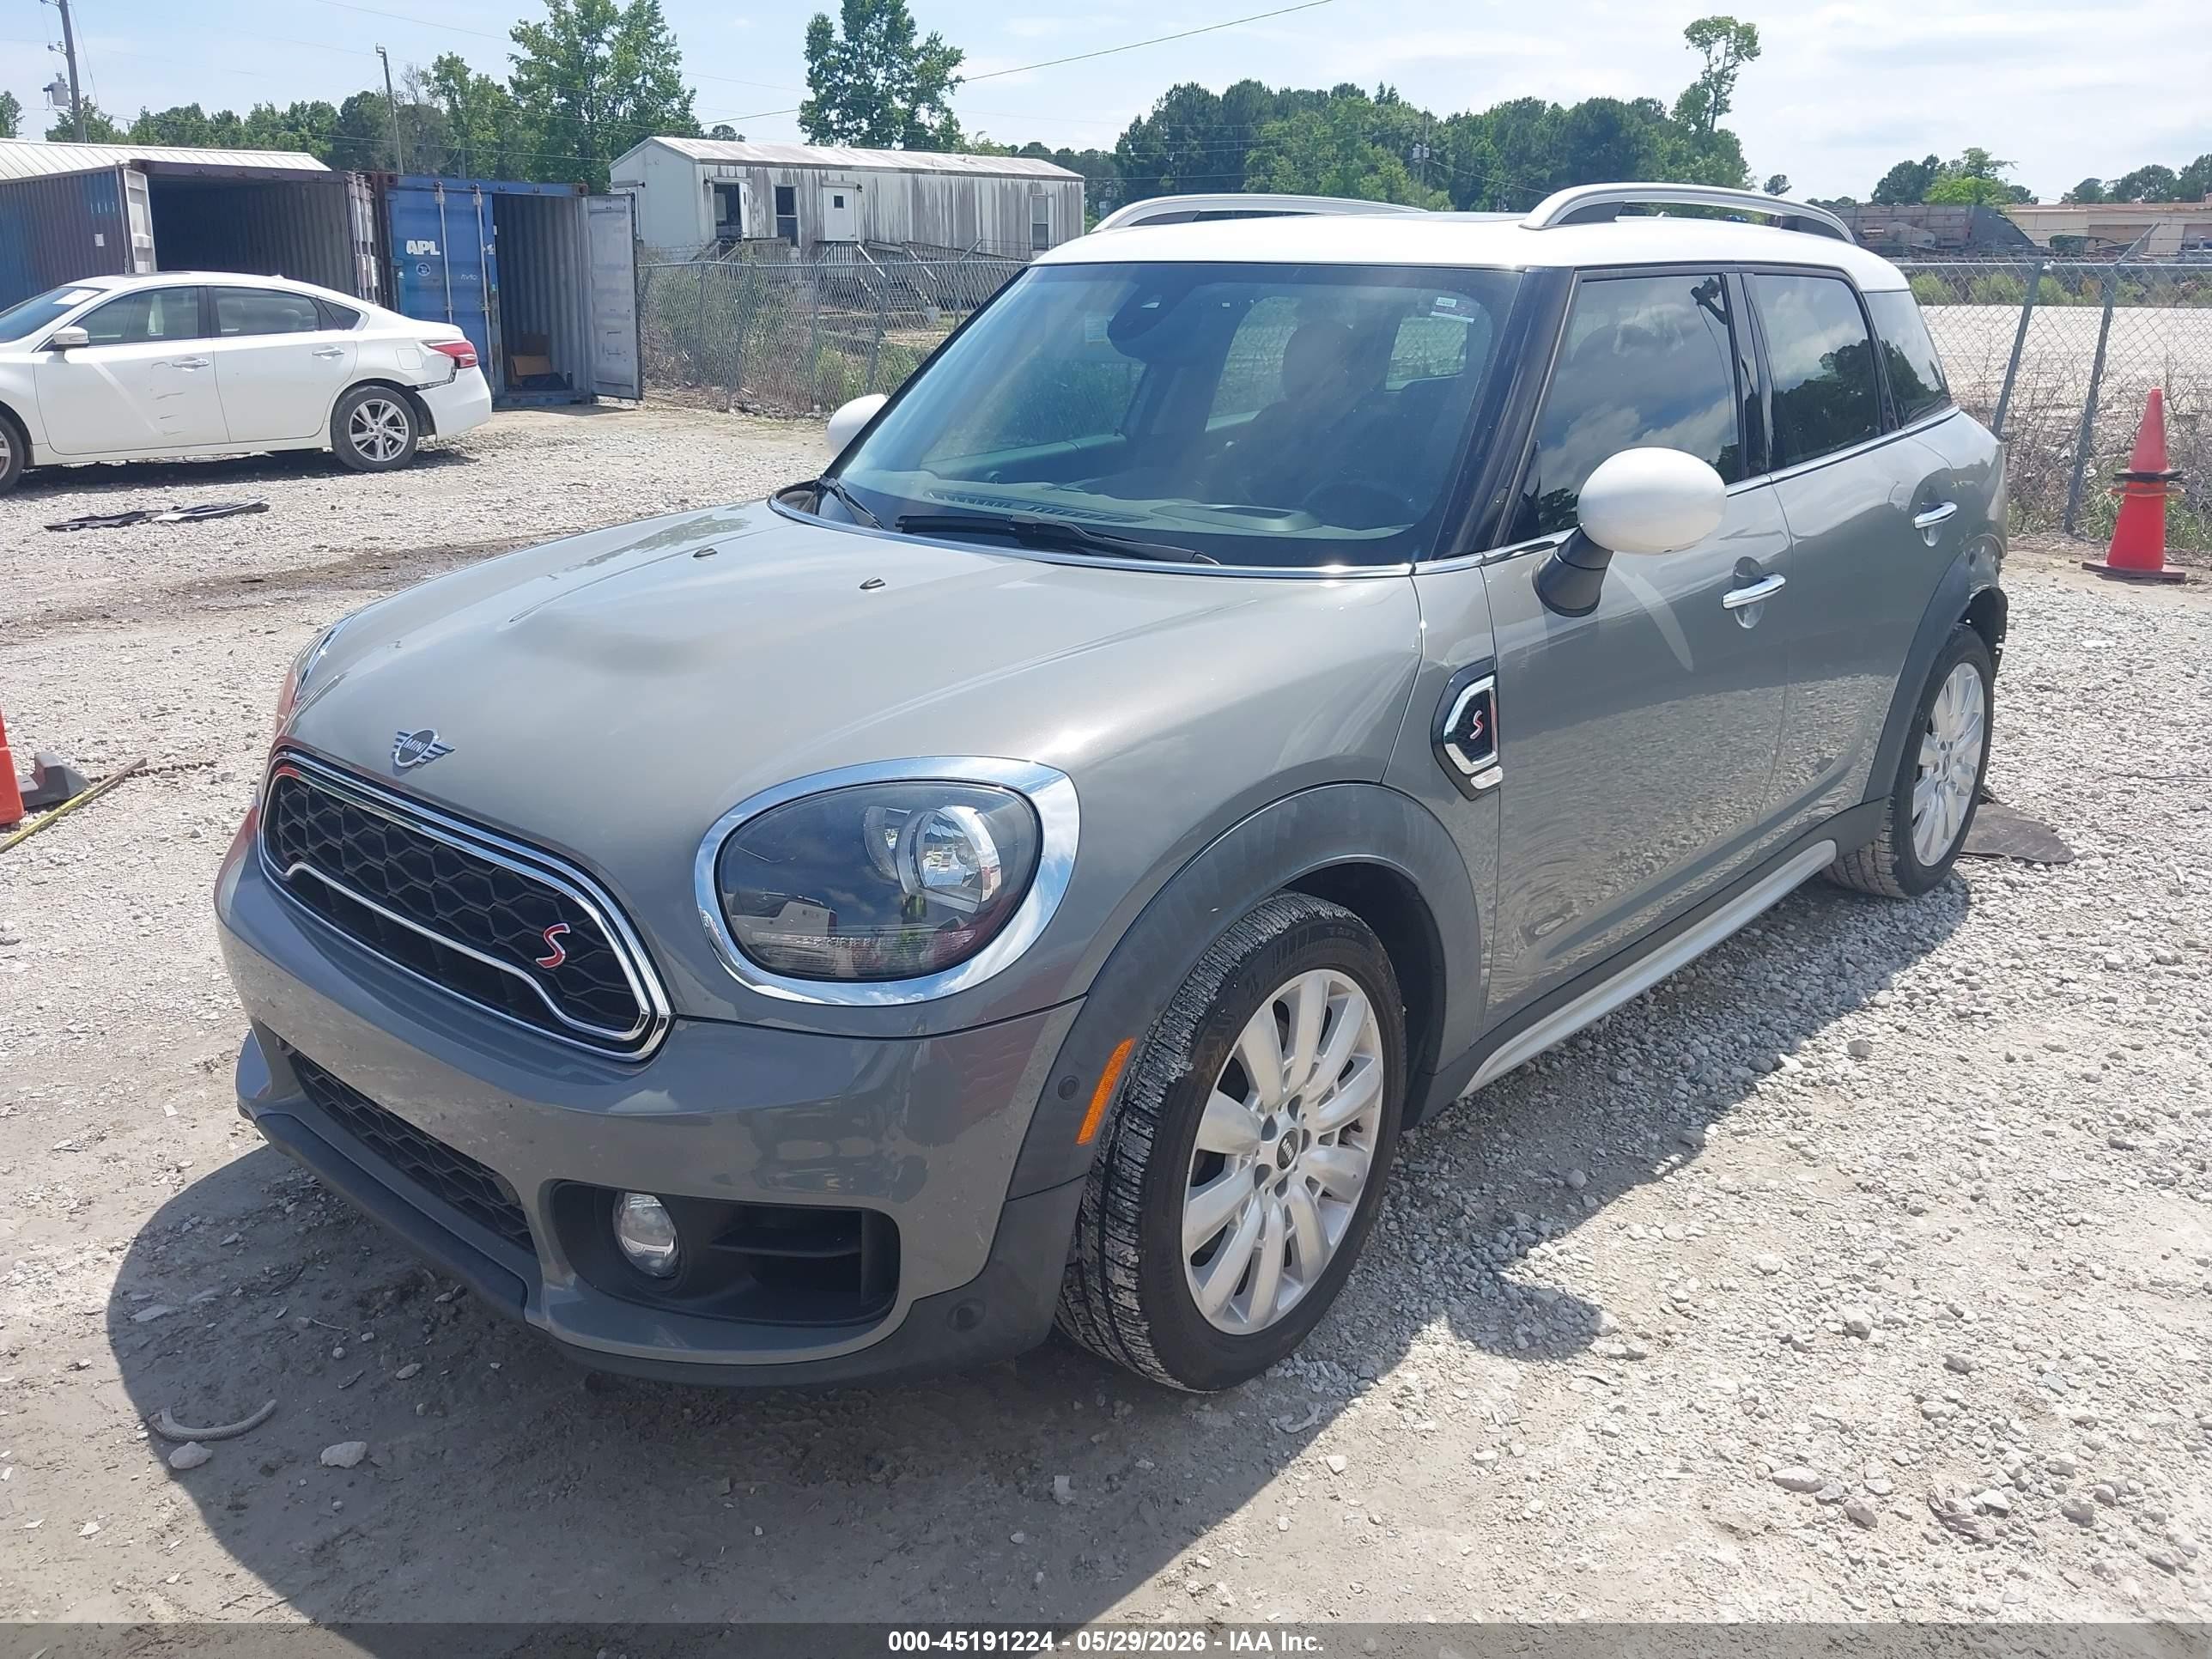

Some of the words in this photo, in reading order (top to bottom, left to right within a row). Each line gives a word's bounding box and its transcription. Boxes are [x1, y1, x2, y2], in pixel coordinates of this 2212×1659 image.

[406, 240, 441, 255] APL
[1469, 709, 1484, 739] S
[404, 738, 428, 753] MINI
[536, 922, 571, 969] S
[1280, 1138, 1294, 1161] MINI
